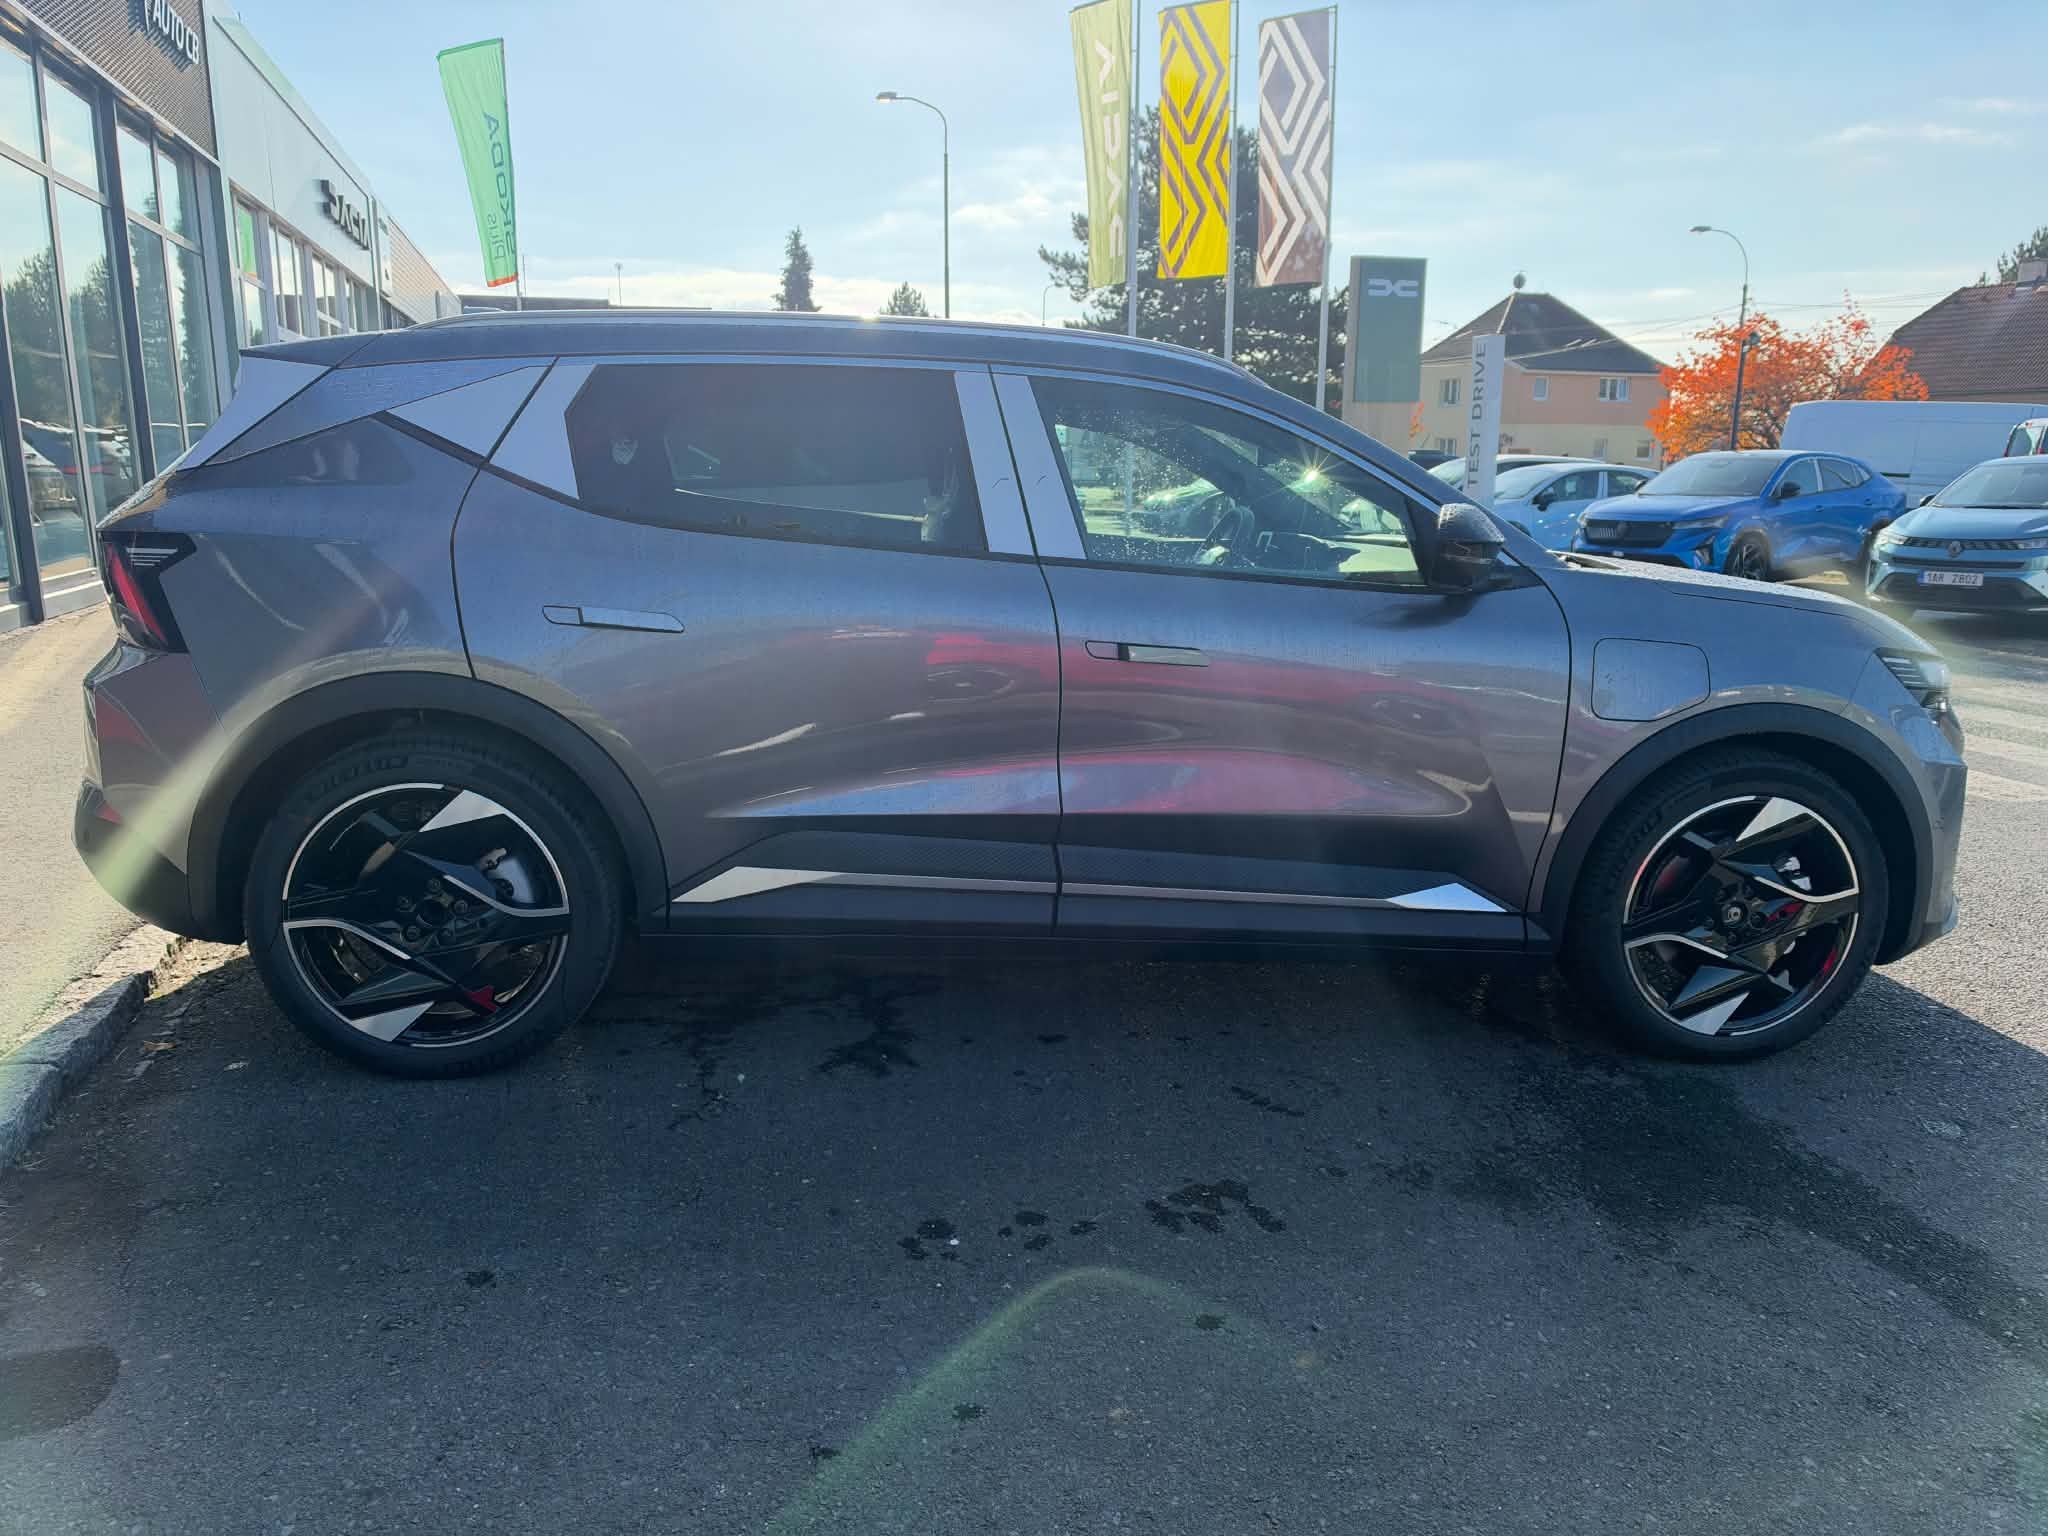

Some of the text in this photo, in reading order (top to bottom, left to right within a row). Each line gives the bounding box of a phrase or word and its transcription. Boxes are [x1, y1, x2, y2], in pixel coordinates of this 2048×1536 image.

[152, 0, 199, 65] AUTO CB
[1467, 342, 1487, 488] TEST DRIVE
